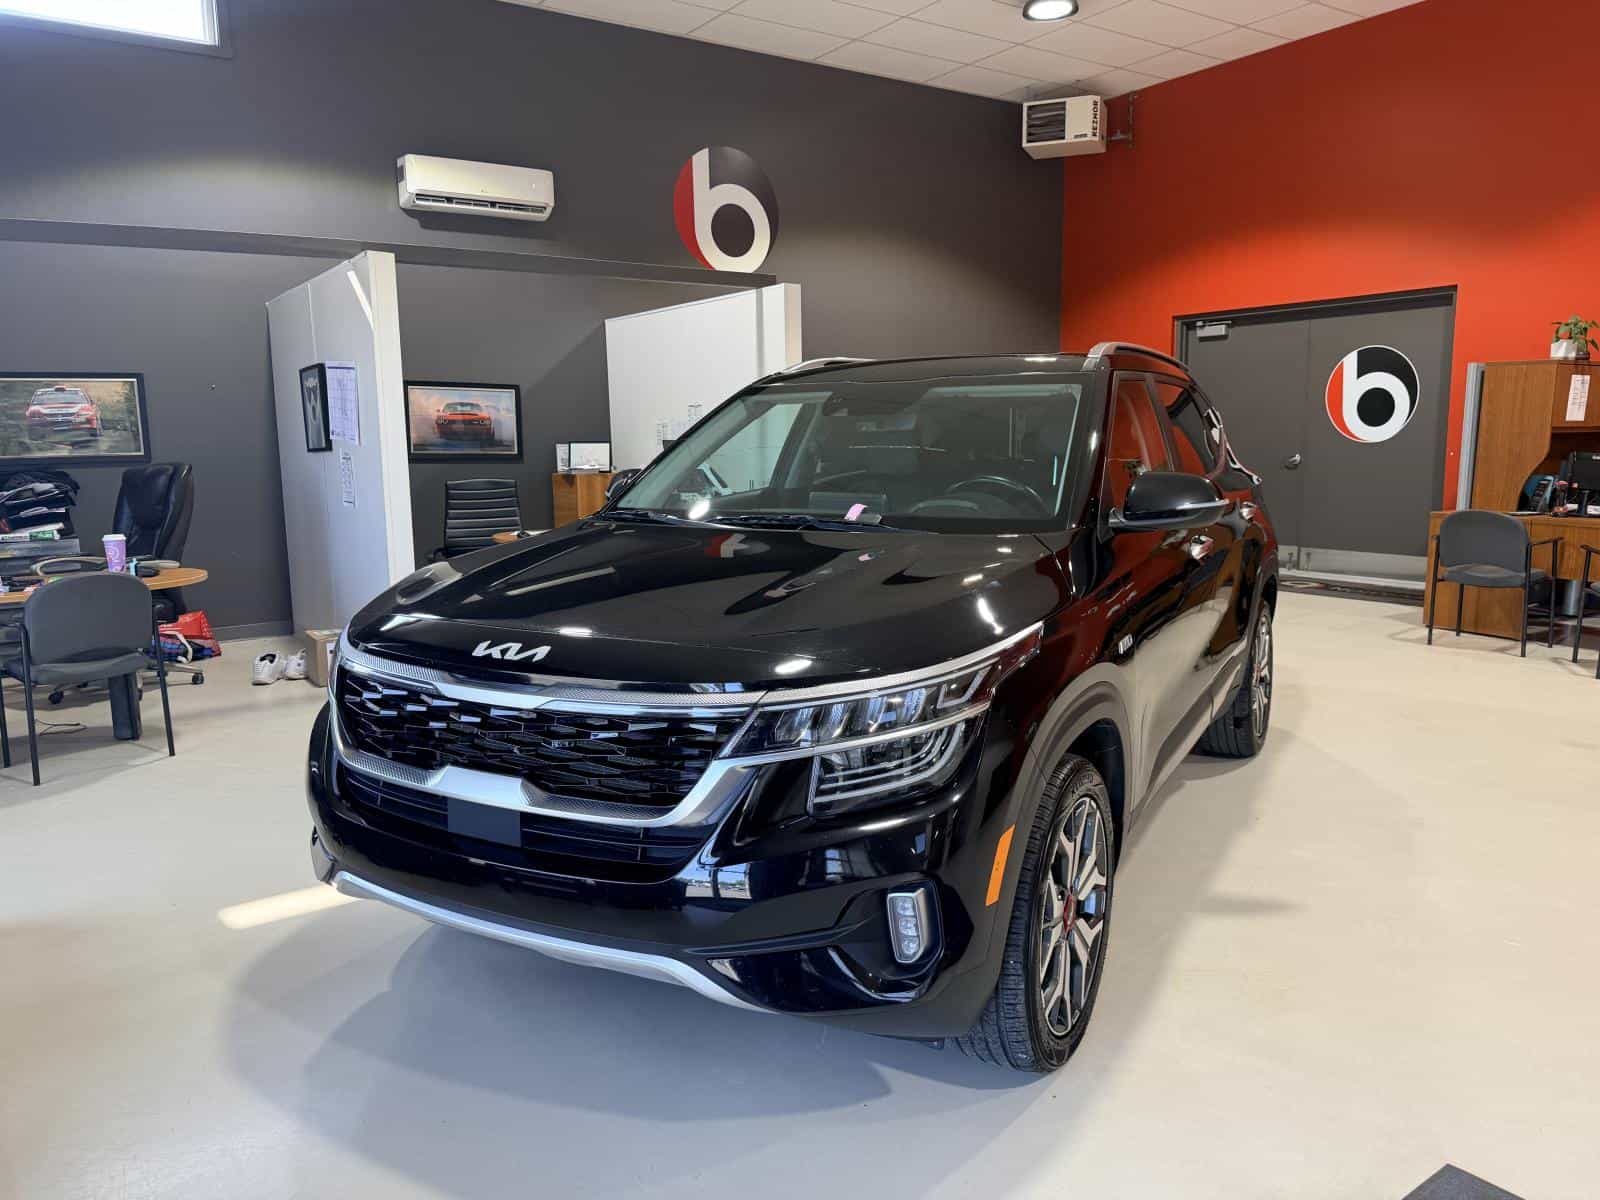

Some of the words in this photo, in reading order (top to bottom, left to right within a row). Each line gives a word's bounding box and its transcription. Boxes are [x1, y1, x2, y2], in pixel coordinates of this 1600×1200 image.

[691, 146, 771, 274] b
[1342, 349, 1411, 443] b
[471, 640, 552, 662] KIA
